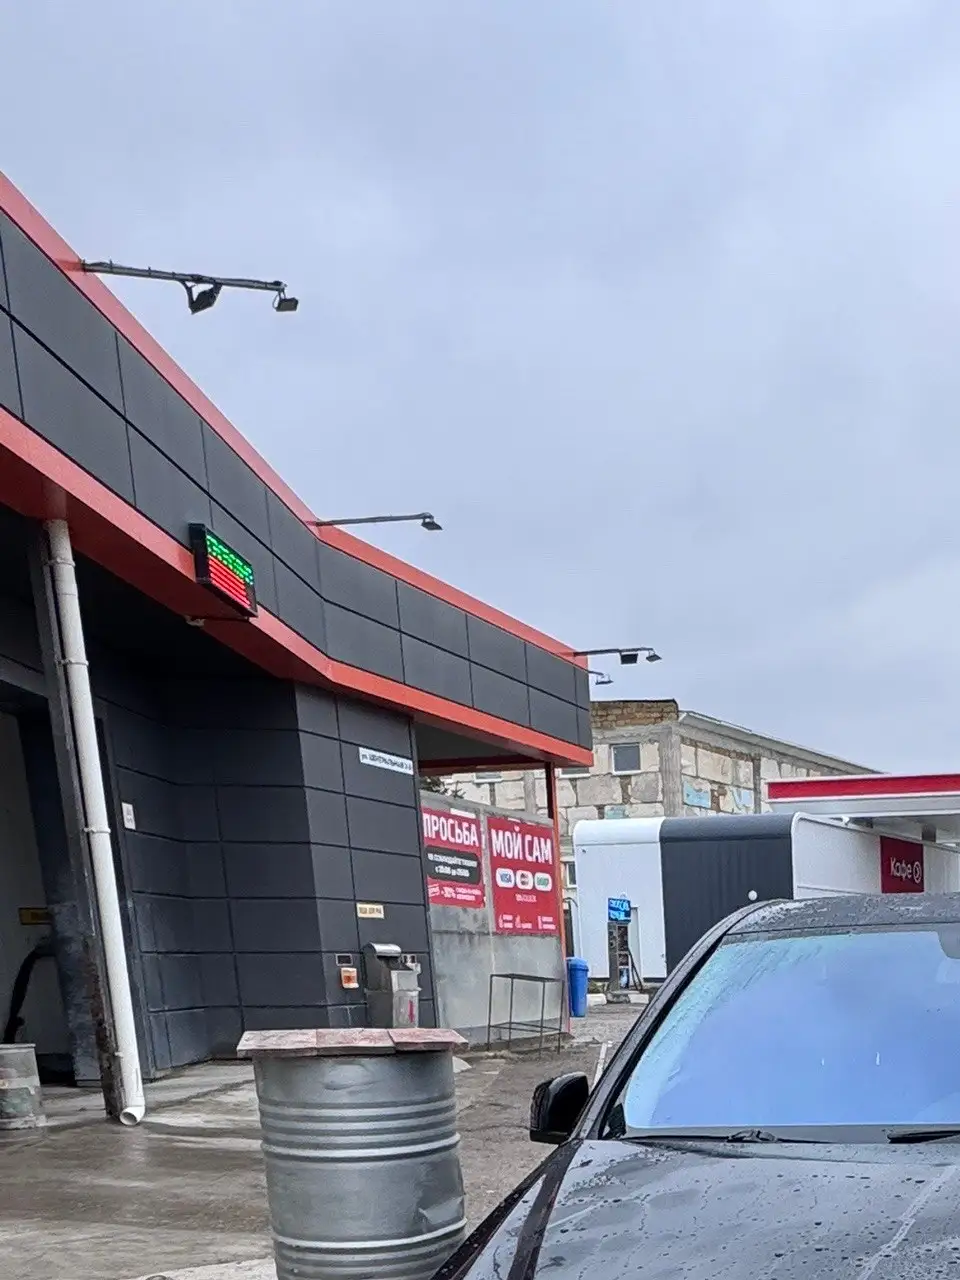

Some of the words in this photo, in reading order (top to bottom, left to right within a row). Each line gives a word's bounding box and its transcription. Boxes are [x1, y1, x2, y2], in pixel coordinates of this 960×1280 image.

[422, 813, 479, 847] ПРОСЬБА
[491, 825, 522, 860] МОЙ
[525, 834, 553, 865] САМ
[890, 856, 912, 881] Кафе
